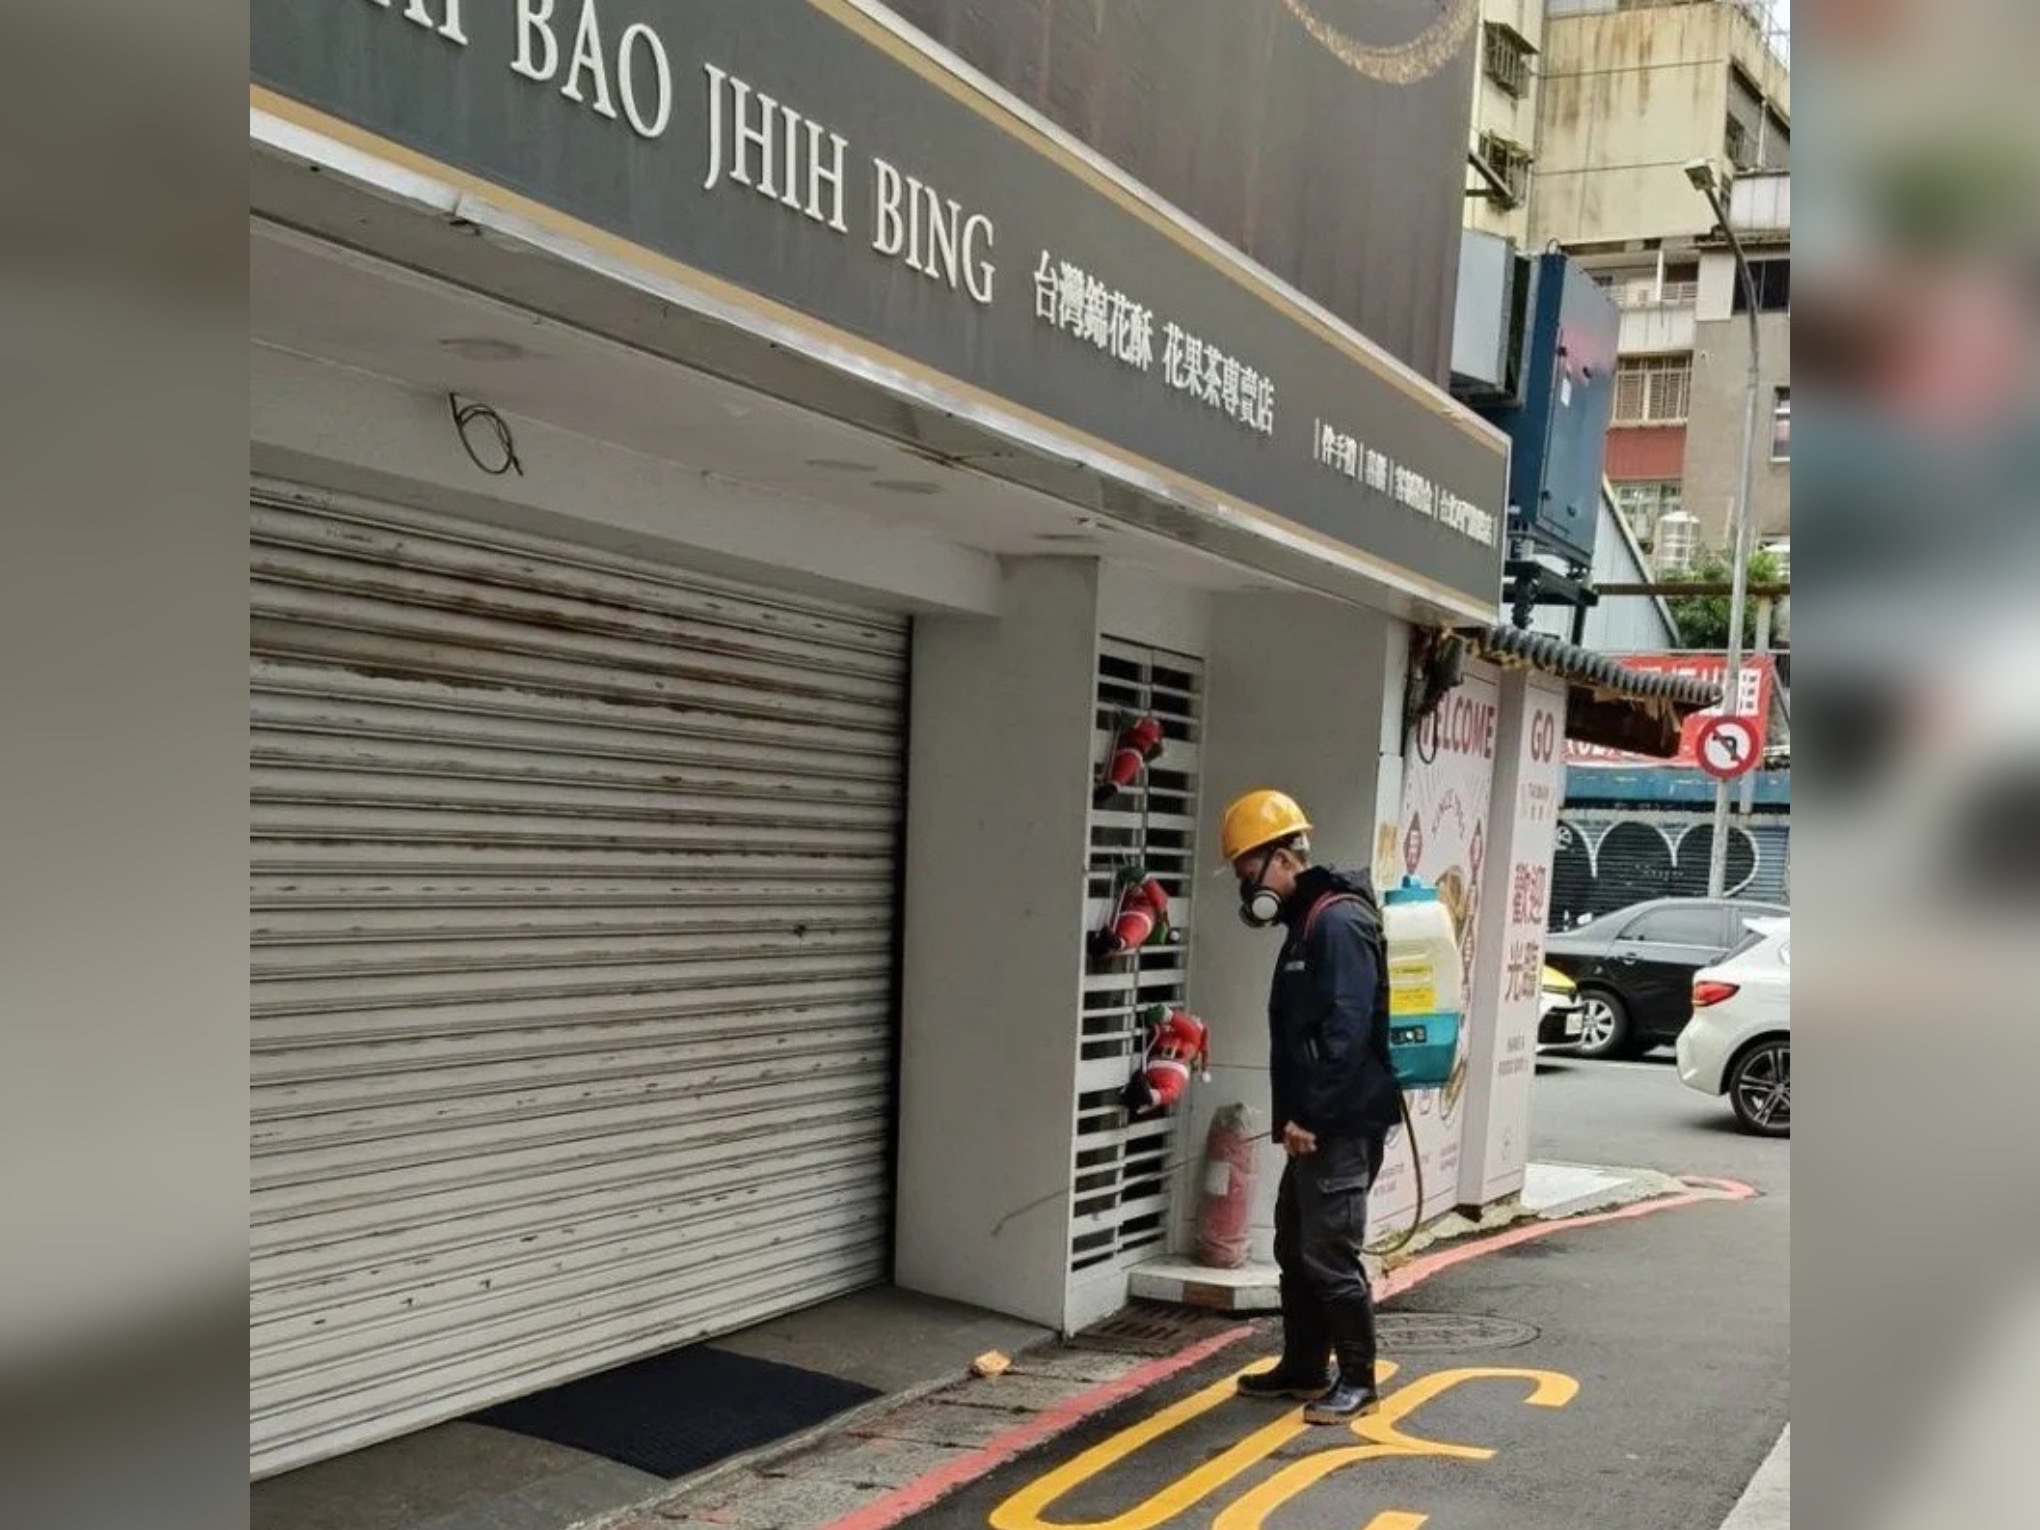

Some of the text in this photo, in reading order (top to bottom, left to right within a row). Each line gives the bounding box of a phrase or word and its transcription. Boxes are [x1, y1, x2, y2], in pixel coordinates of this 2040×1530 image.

[509, 0, 997, 304] BAO JHIH BING
[1162, 321, 1275, 435] 花果茶專賣店
[1531, 709, 1555, 763] GO
